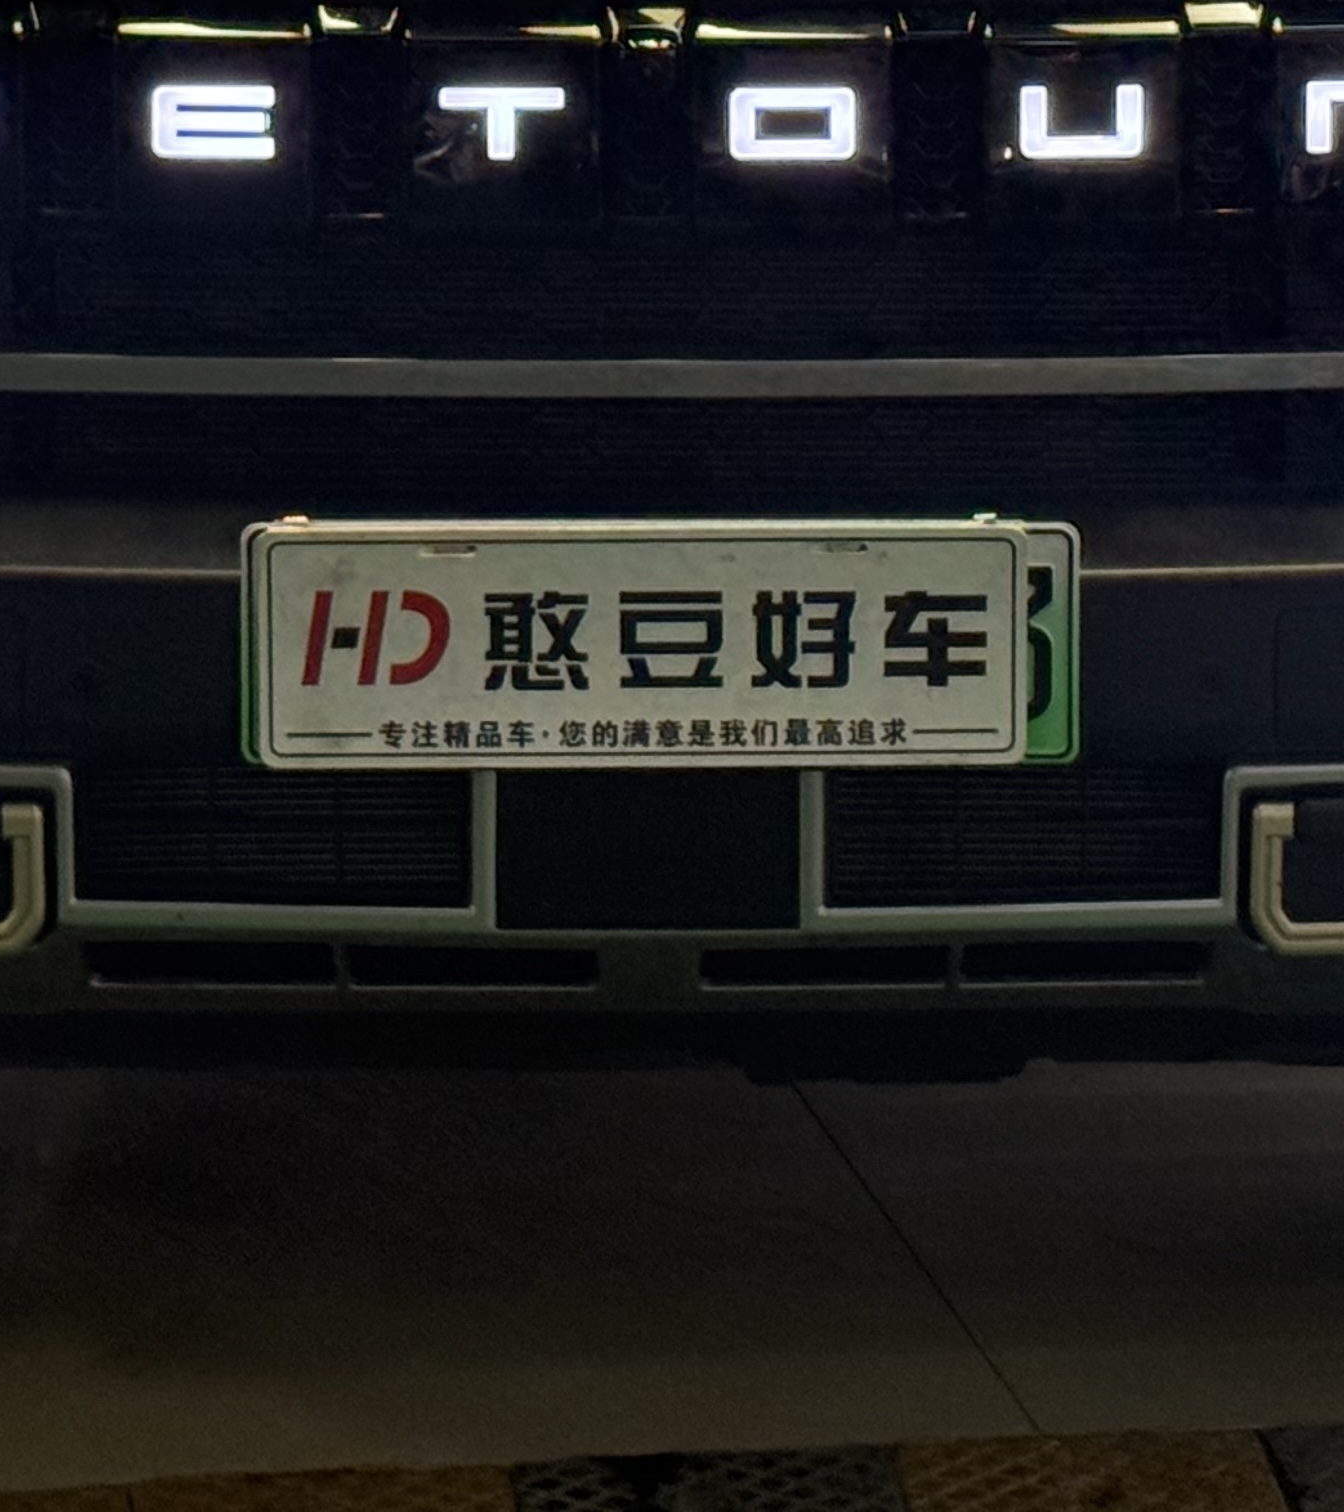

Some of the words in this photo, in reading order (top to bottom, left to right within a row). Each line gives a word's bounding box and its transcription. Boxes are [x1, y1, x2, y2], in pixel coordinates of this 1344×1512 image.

[301, 590, 452, 686] HD
[484, 590, 988, 691] 憨豆好车
